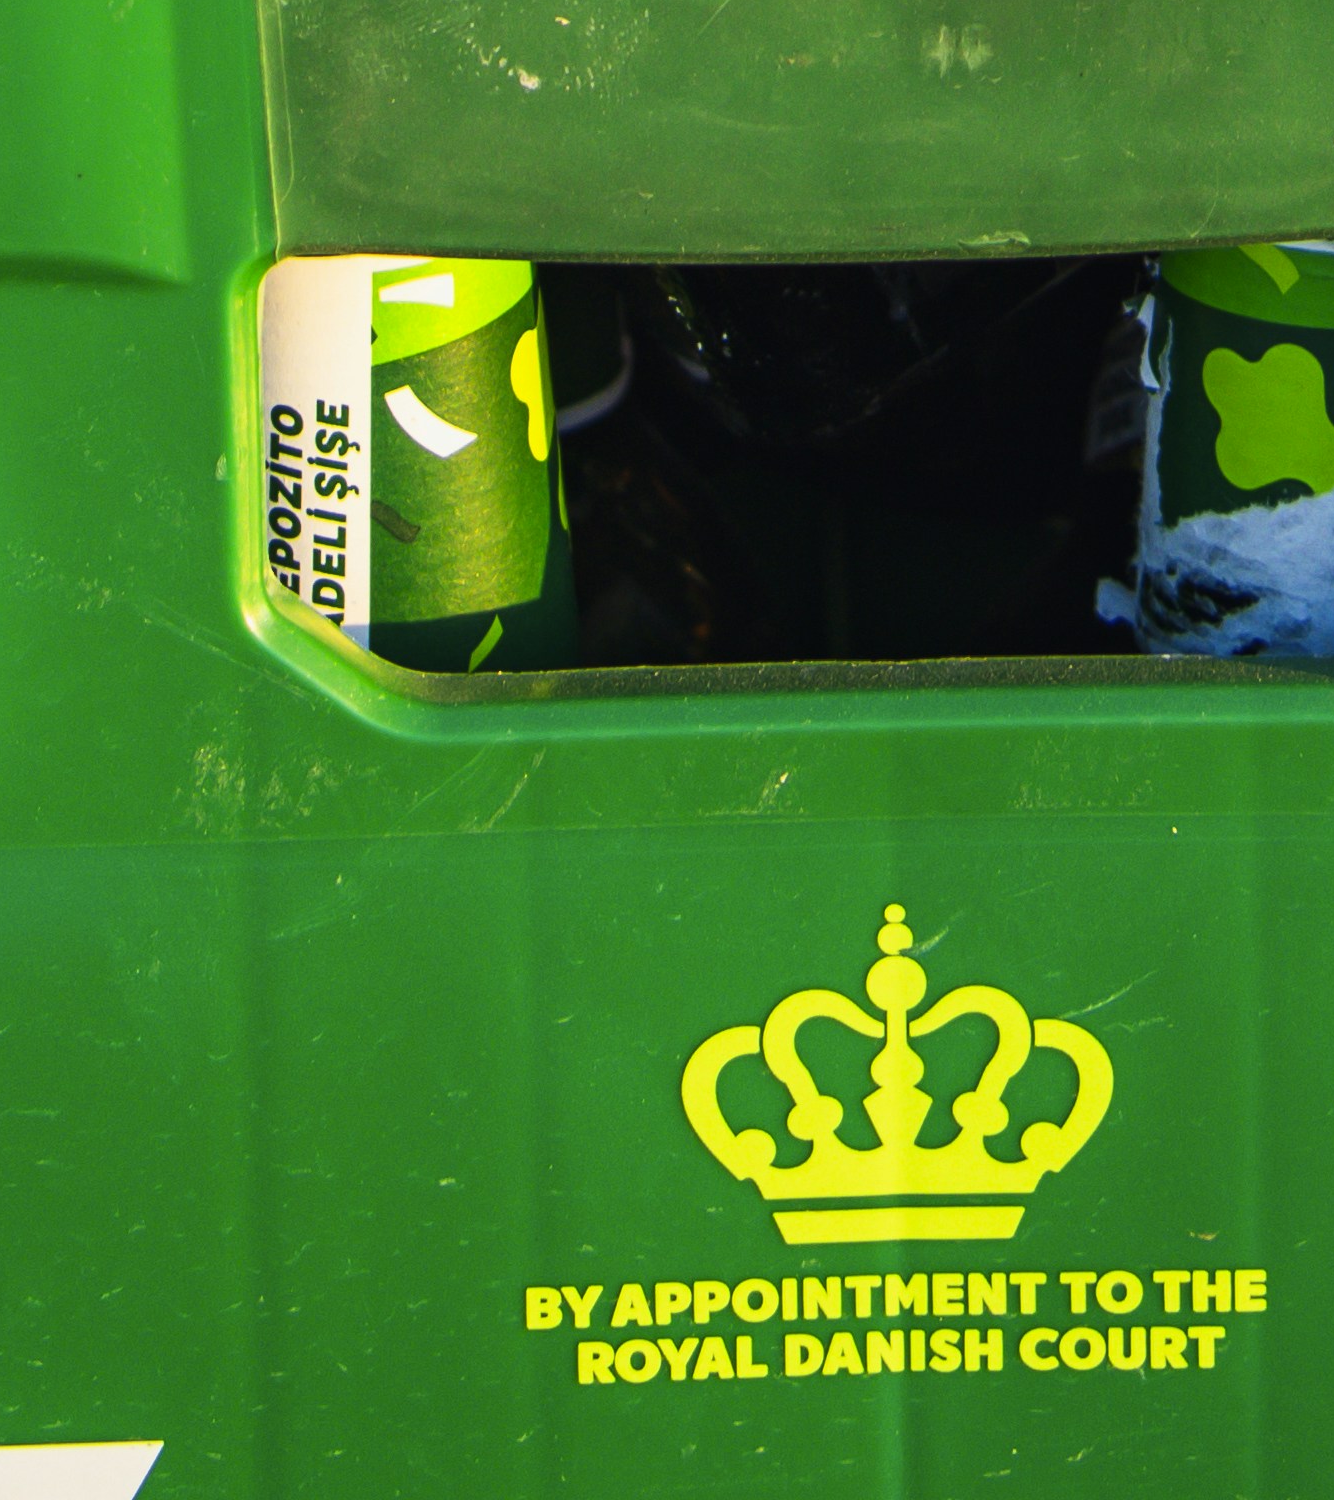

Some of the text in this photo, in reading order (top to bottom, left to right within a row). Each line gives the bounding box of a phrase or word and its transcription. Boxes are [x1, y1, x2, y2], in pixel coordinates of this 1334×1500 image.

[307, 399, 360, 500] ŞİŞE
[525, 1269, 1268, 1331] BY APPOINTMENT TO THE
[576, 1326, 1226, 1385] ROYAL DANISH COURT
